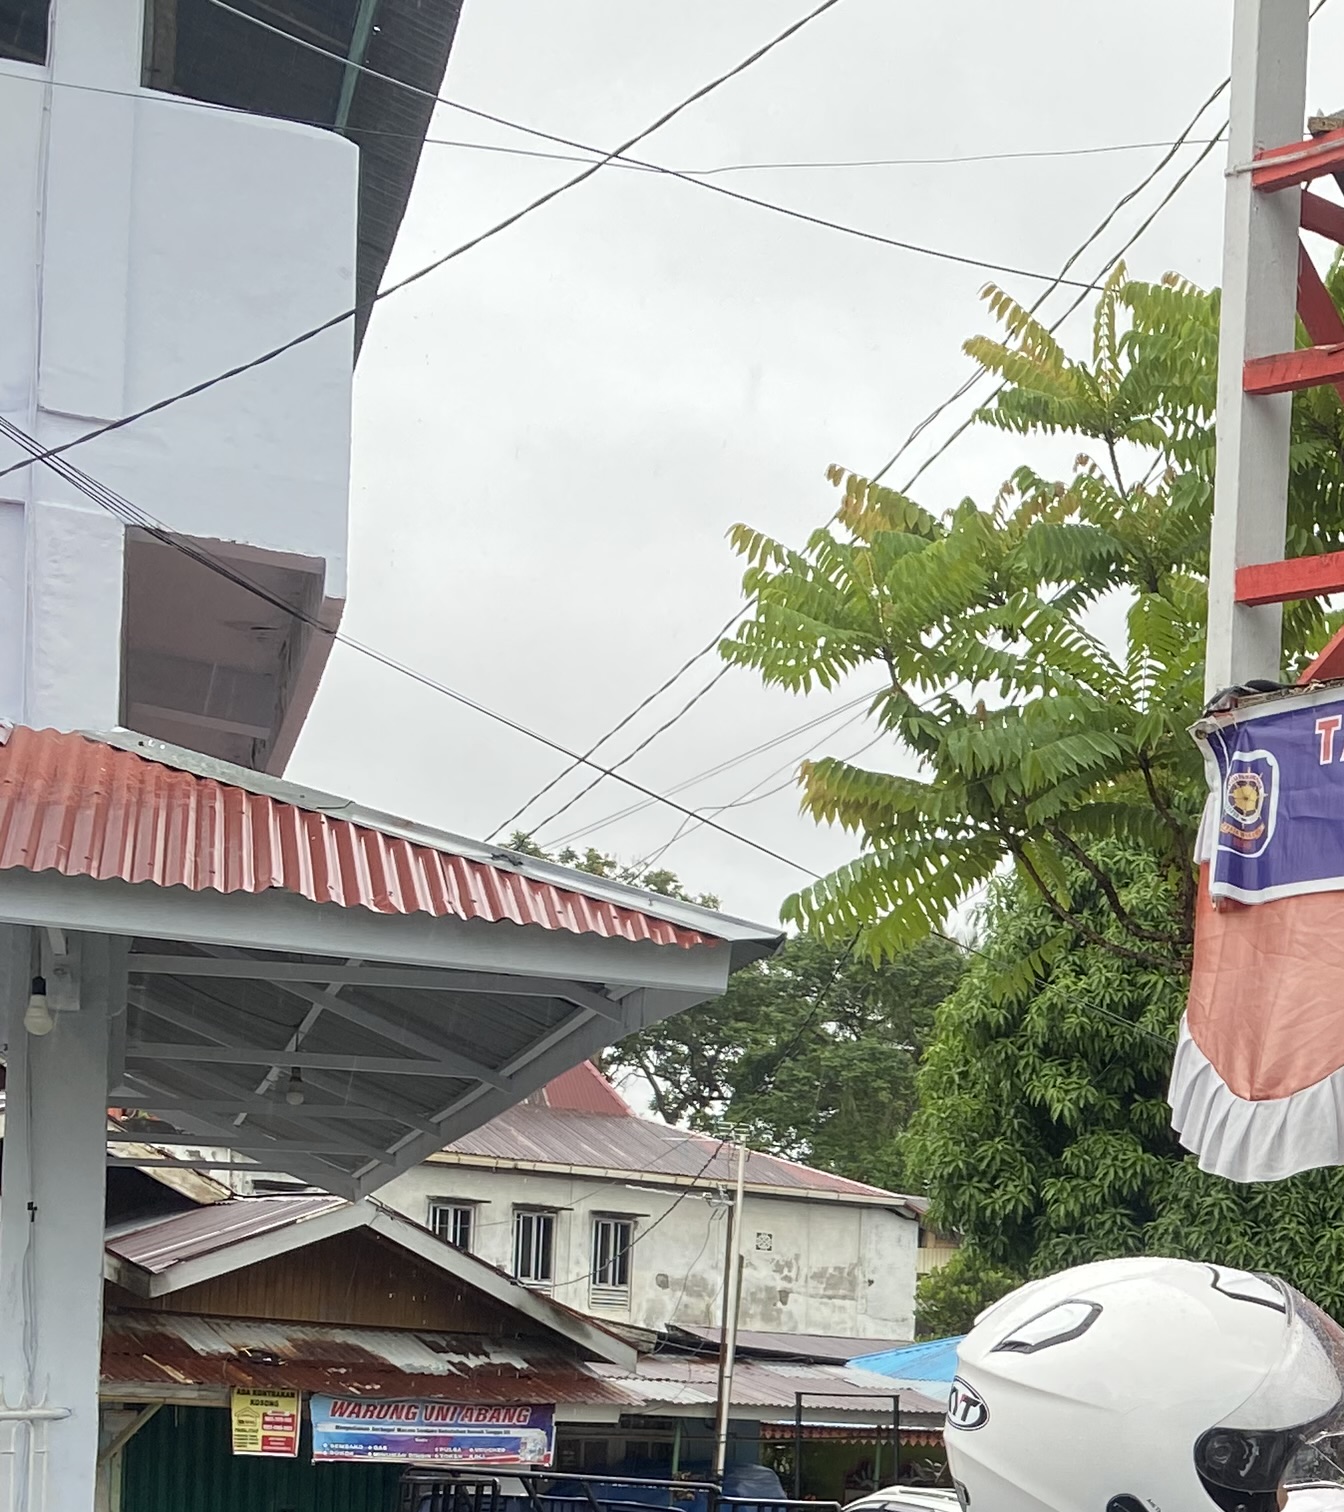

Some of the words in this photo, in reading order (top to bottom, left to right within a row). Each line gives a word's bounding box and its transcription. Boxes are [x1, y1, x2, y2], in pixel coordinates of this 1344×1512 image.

[330, 1400, 419, 1422] WARUNG
[422, 1403, 459, 1423] UNI
[458, 1405, 532, 1425] ABANG
